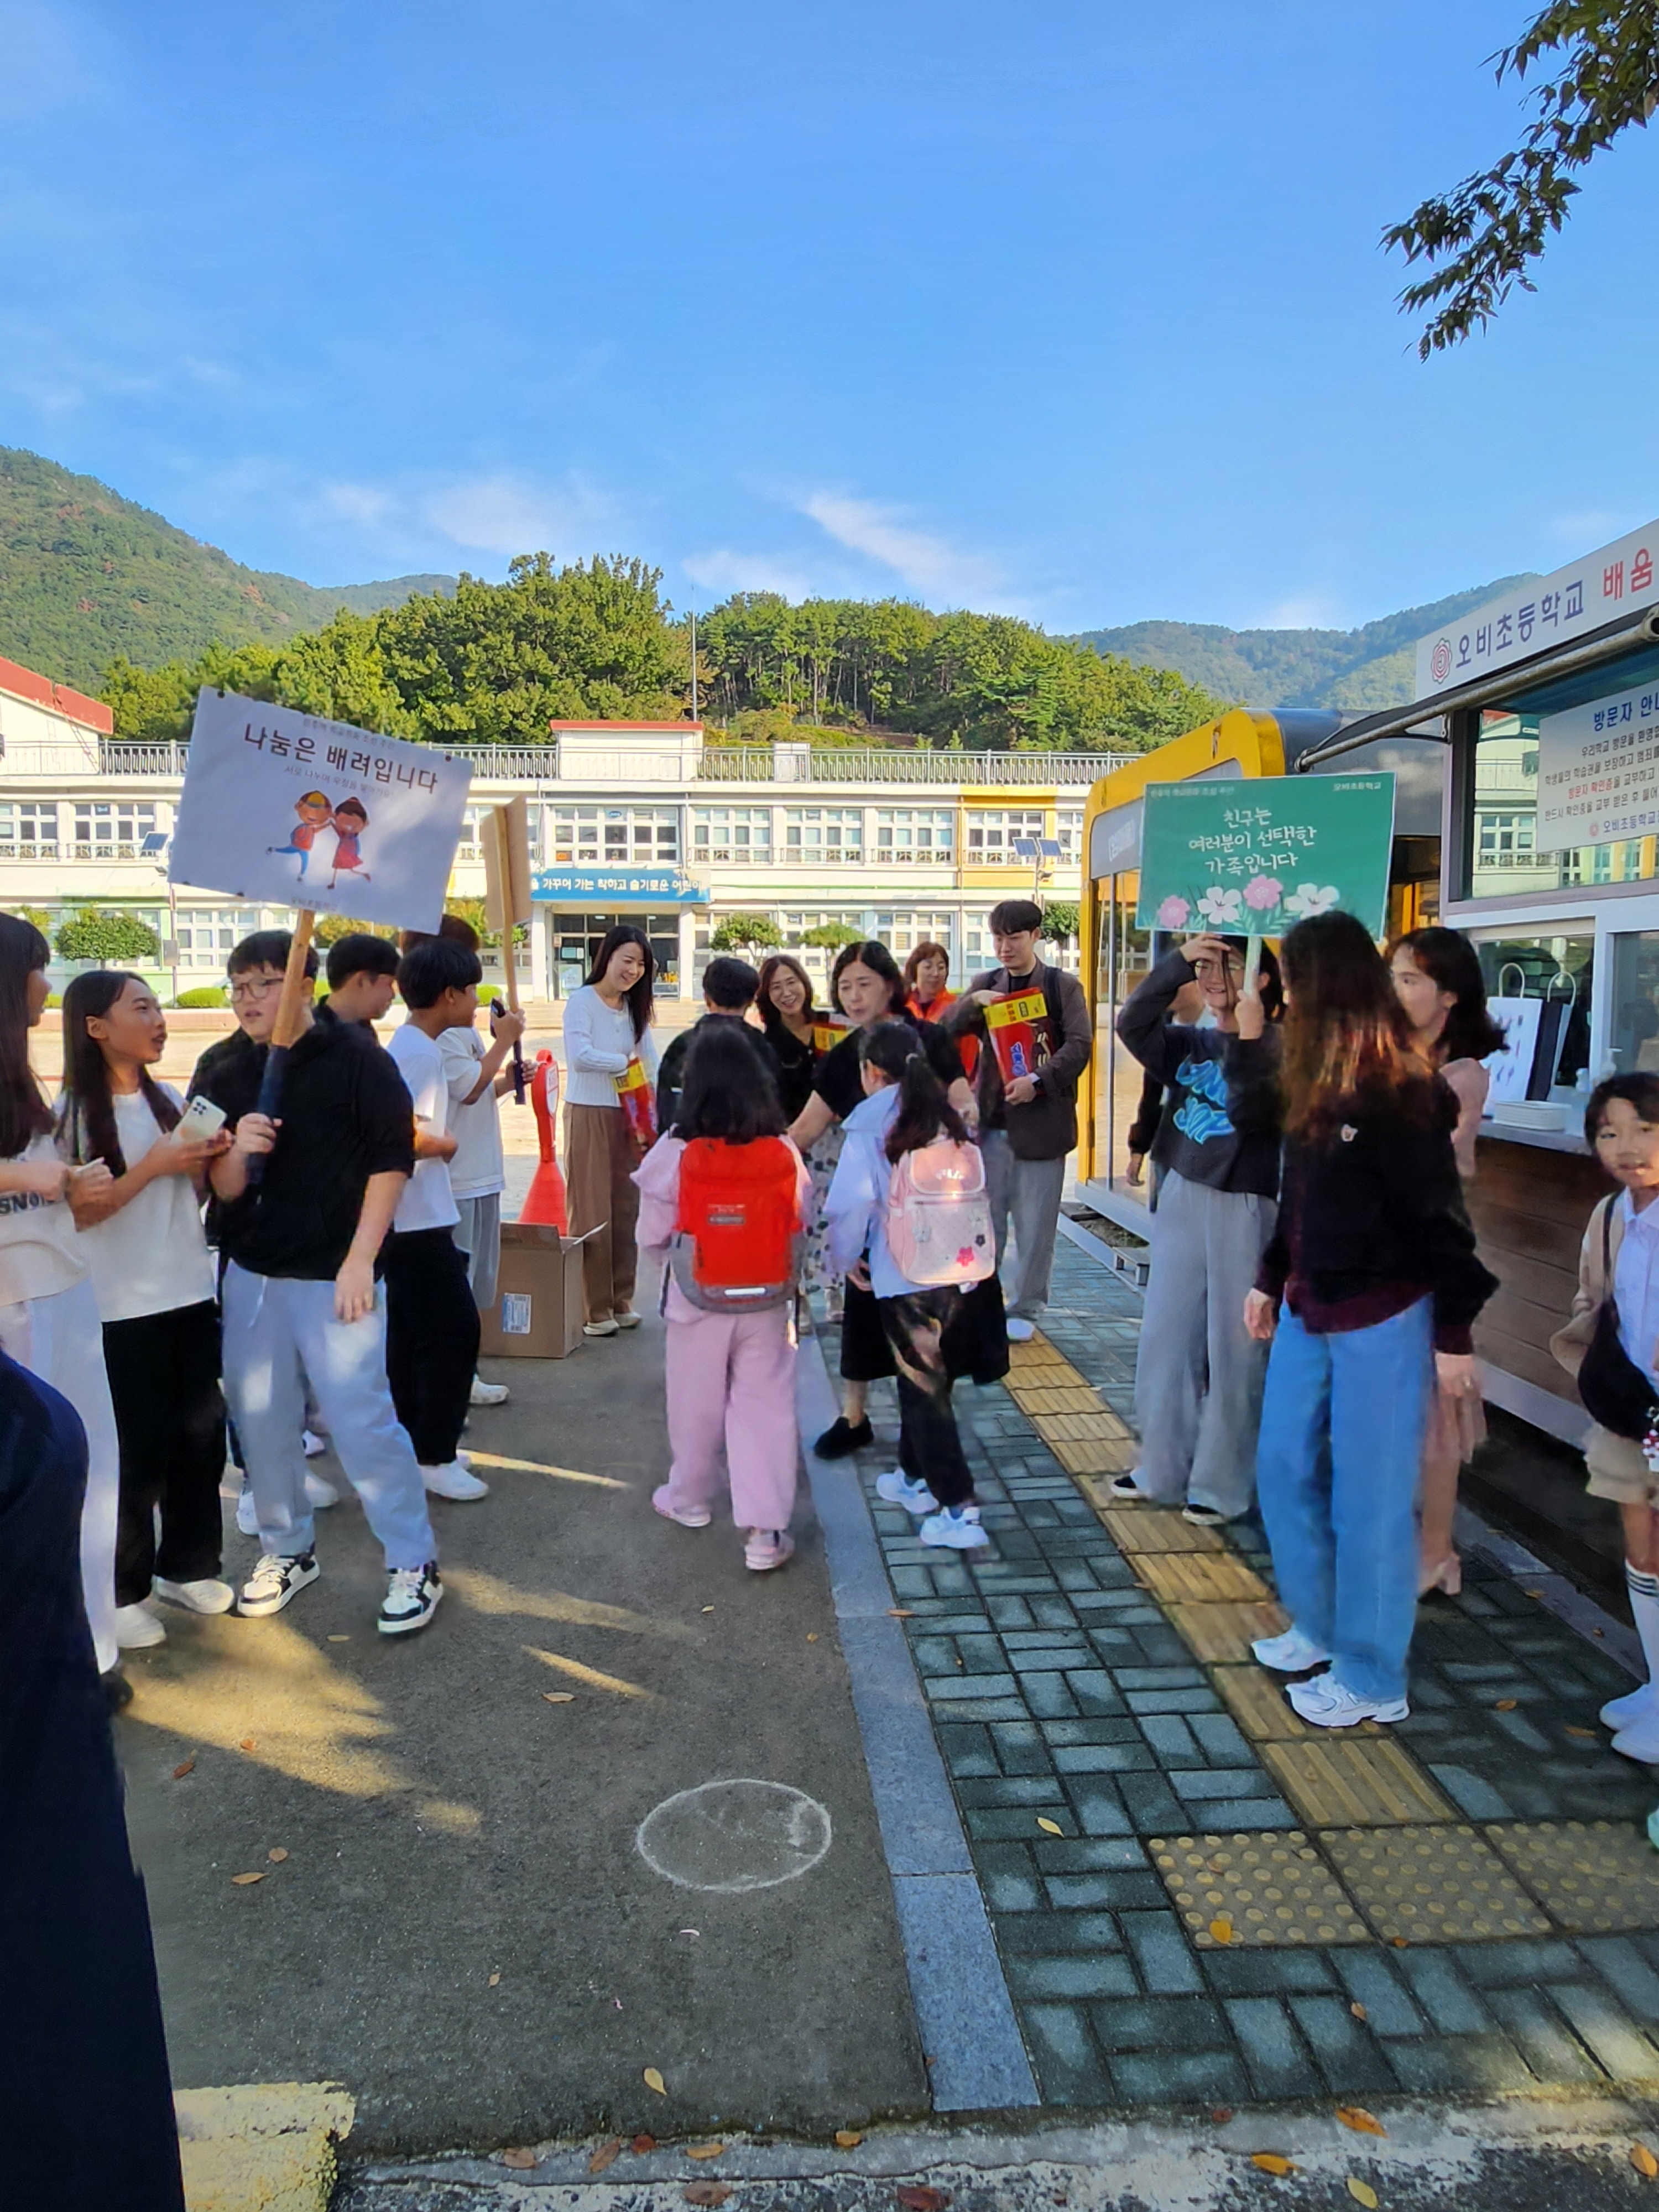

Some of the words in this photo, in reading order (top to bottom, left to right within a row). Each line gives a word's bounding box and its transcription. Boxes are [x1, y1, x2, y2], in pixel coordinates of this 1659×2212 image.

[1455, 580, 1584, 669] 오비초등학교
[1603, 547, 1653, 601] 배움
[1594, 701, 1632, 732] 방문자
[244, 722, 317, 764] 나눔은
[326, 745, 438, 795] 배려입니다
[1582, 740, 1609, 758] 우리학교
[1613, 733, 1634, 750] 방문을
[284, 766, 302, 776] 서로
[305, 770, 331, 783] 나누며
[333, 776, 357, 790] 우정을
[1545, 770, 1571, 786] 학생들의
[1574, 761, 1601, 778] 학습권을
[1604, 753, 1634, 771] 보장하고
[1568, 784, 1588, 799] 방문자
[1591, 776, 1620, 792] 확인증을
[1624, 767, 1655, 786] 교부하고
[1545, 807, 1563, 821] 반드시
[1566, 801, 1593, 816] 확인증을
[1596, 797, 1610, 811] 교부
[1614, 794, 1628, 807] 받은
[1631, 791, 1639, 804] 후
[1643, 786, 1659, 801] 들어
[1223, 807, 1272, 828] 친구는
[1604, 810, 1659, 833] 오비초등학교
[1189, 831, 1251, 853] 여러분이
[1257, 826, 1317, 847] 선택한
[1204, 852, 1298, 876] 가족입니다
[542, 878, 572, 891] 가꾸어
[575, 878, 594, 890] 가는
[598, 878, 627, 891] 착하고
[630, 878, 669, 892] 슬기로운
[672, 879, 701, 892] 어린이
